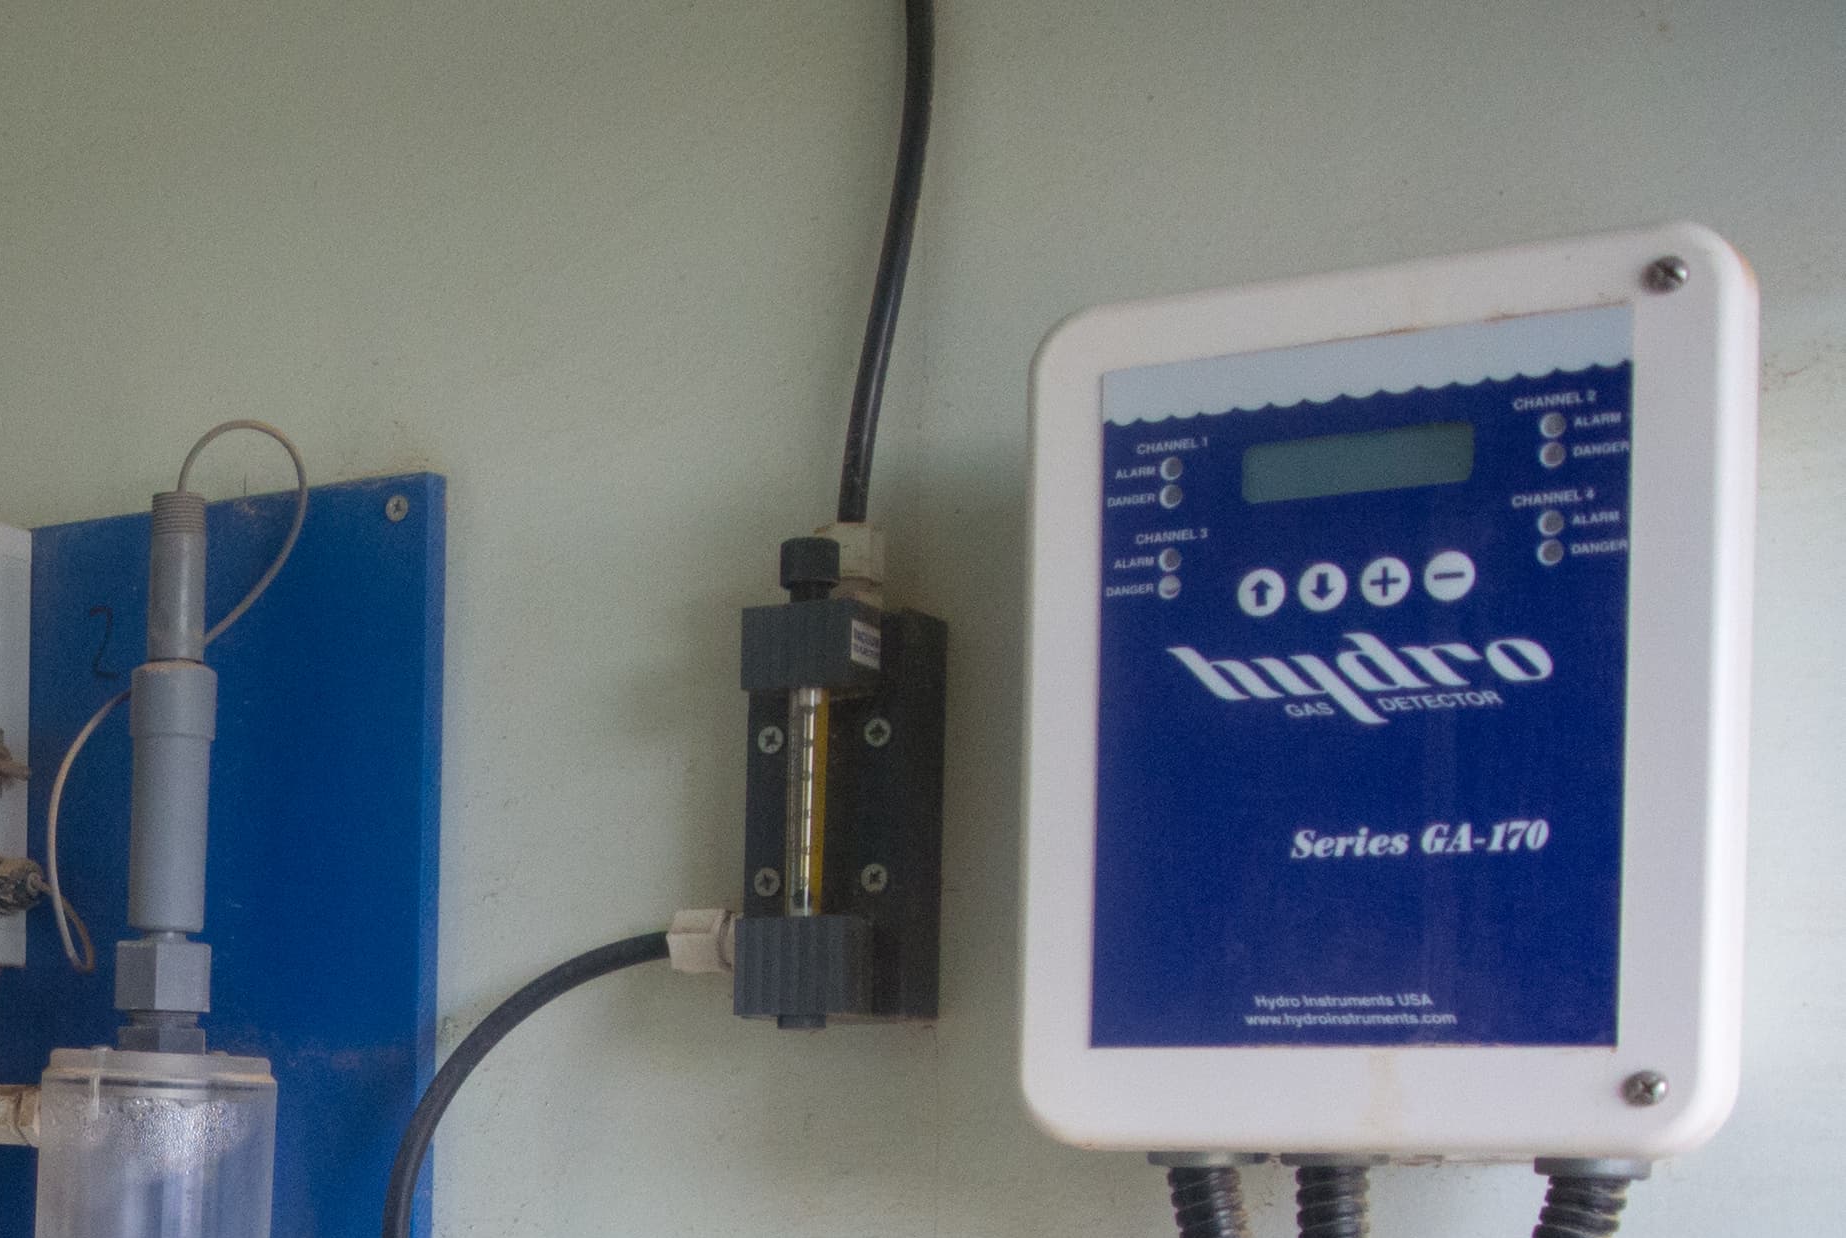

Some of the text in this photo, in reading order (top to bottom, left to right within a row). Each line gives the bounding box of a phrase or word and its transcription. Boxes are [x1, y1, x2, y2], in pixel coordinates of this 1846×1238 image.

[1512, 389, 1597, 411] CHANNEL 2
[1574, 412, 1622, 427] ALARM
[1136, 437, 1209, 455] CHANNEL 1
[1573, 441, 1630, 457] DANGER
[1115, 466, 1155, 480] ALARM
[1107, 492, 1155, 508] DANGER
[1511, 489, 1581, 508] CHANNEL
[1572, 510, 1620, 525] ALARM
[1135, 528, 1209, 545] CHANNEL 3
[1570, 539, 1629, 555] DANGER
[1113, 556, 1155, 569] ALARM
[1106, 582, 1154, 597] DANGER
[1165, 632, 1554, 724] hydro
[1284, 689, 1503, 718] GAS DETECTOR
[1290, 819, 1550, 859] Series GA-170
[1254, 993, 1434, 1010] Hydro Instruments USA
[1244, 1013, 1458, 1028] www.hydroinstruments.com
